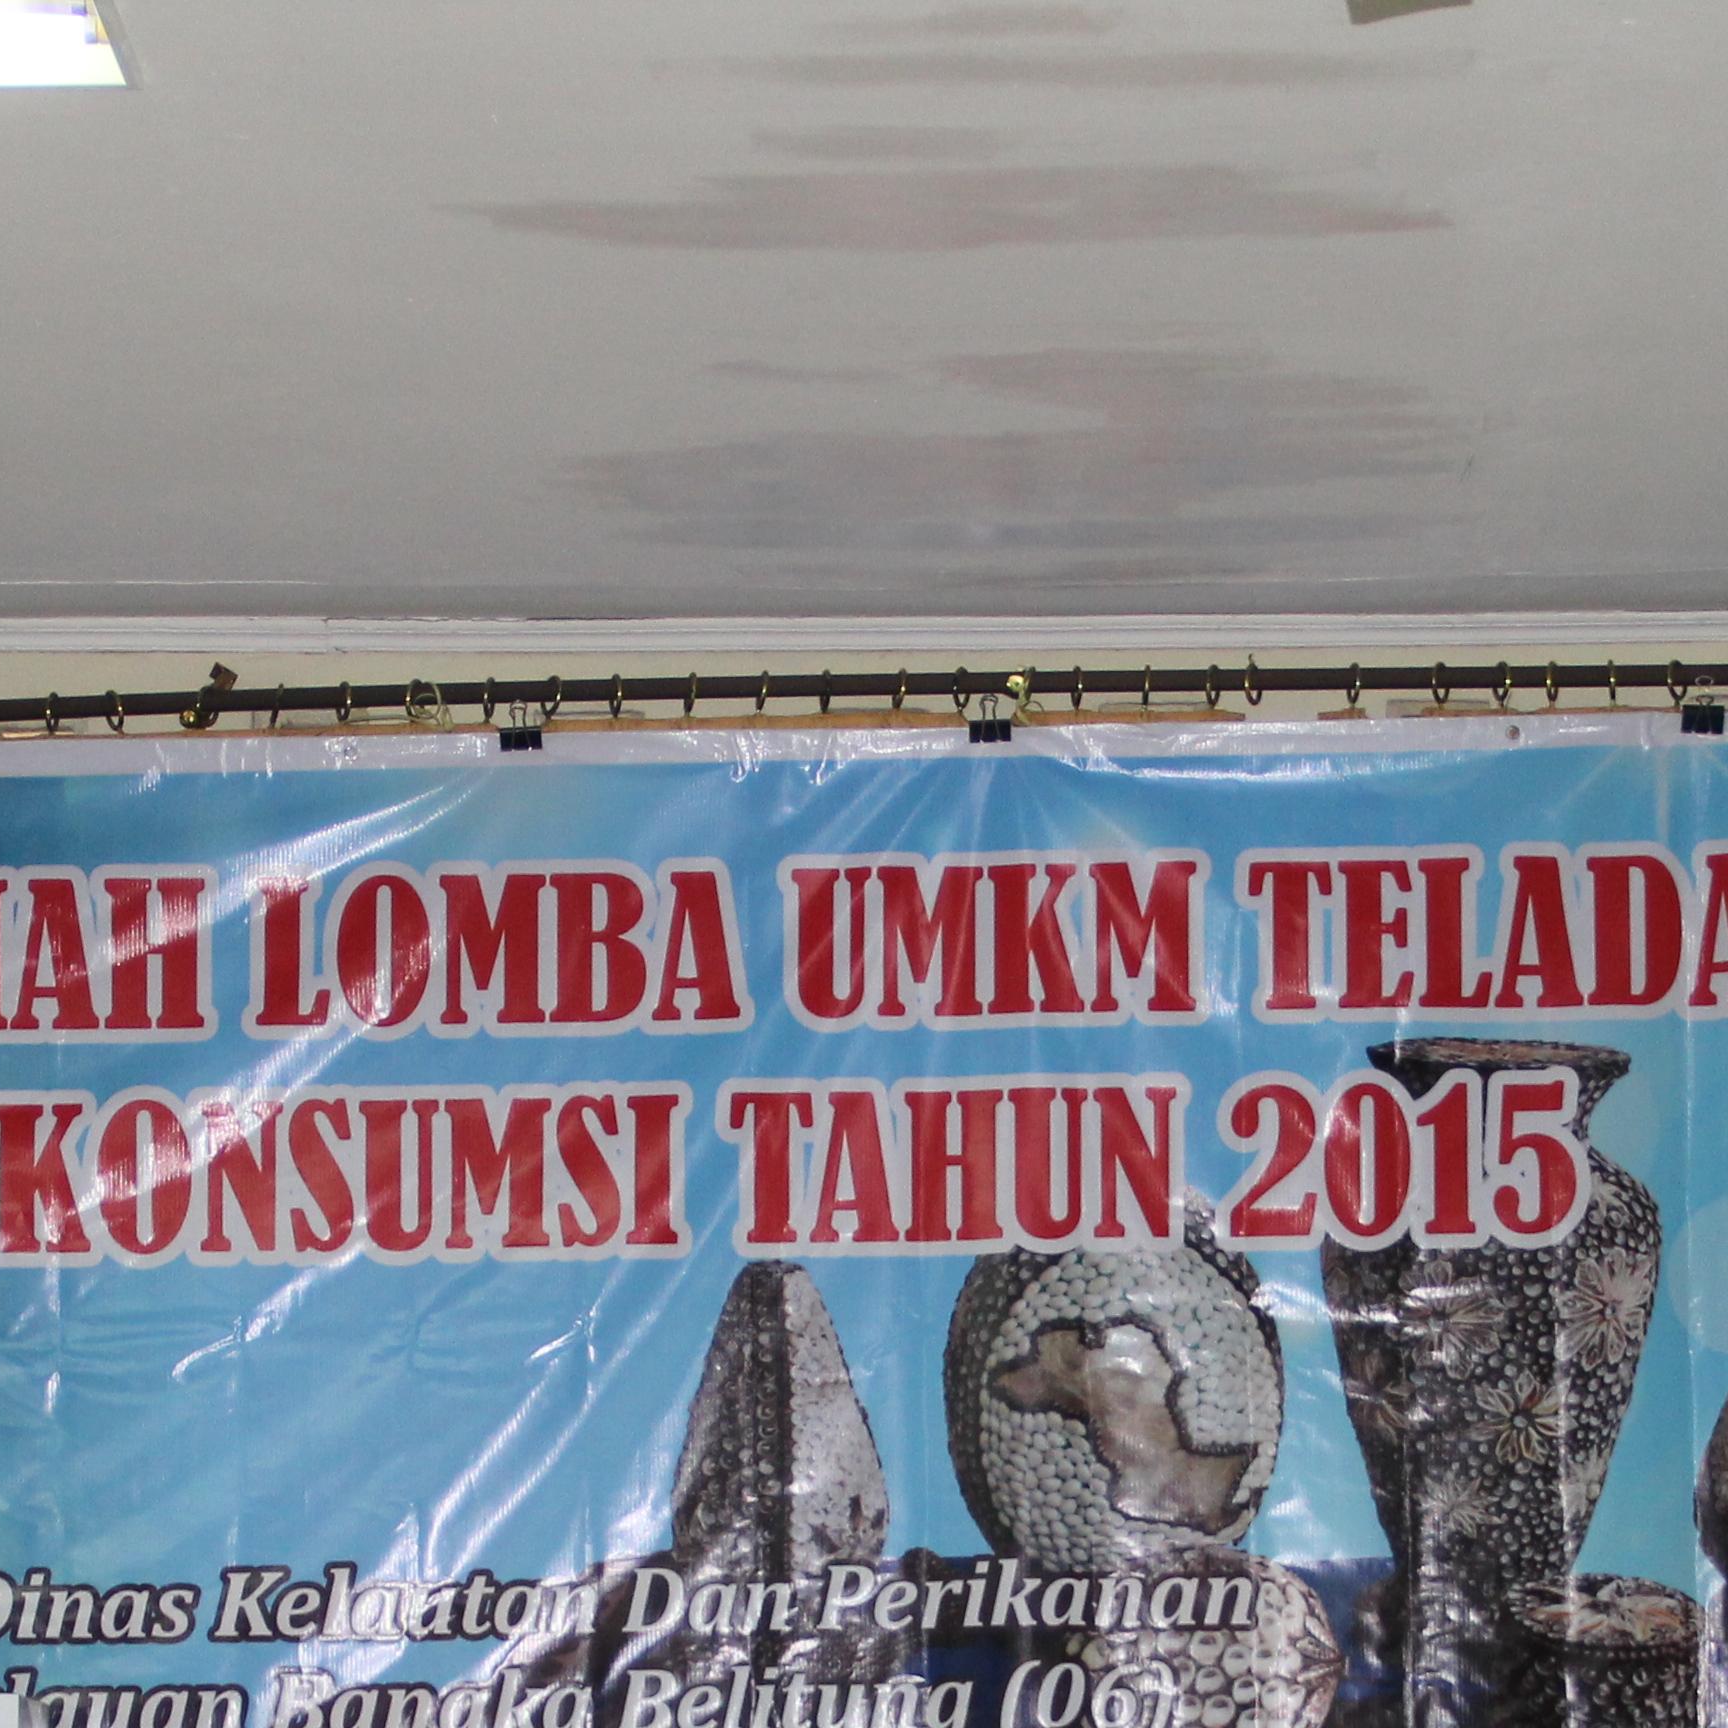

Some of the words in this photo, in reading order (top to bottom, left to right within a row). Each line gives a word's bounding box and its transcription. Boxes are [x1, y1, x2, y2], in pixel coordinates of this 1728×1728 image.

[254, 870, 742, 1027] LOMBA
[790, 862, 1198, 1018] UMKM
[729, 1086, 1177, 1243] TAHUN
[1229, 1080, 1579, 1239] 2015
[212, 1564, 598, 1643] Kelautan
[621, 1566, 799, 1635] Dan
[816, 1556, 1256, 1631] Perikanan
